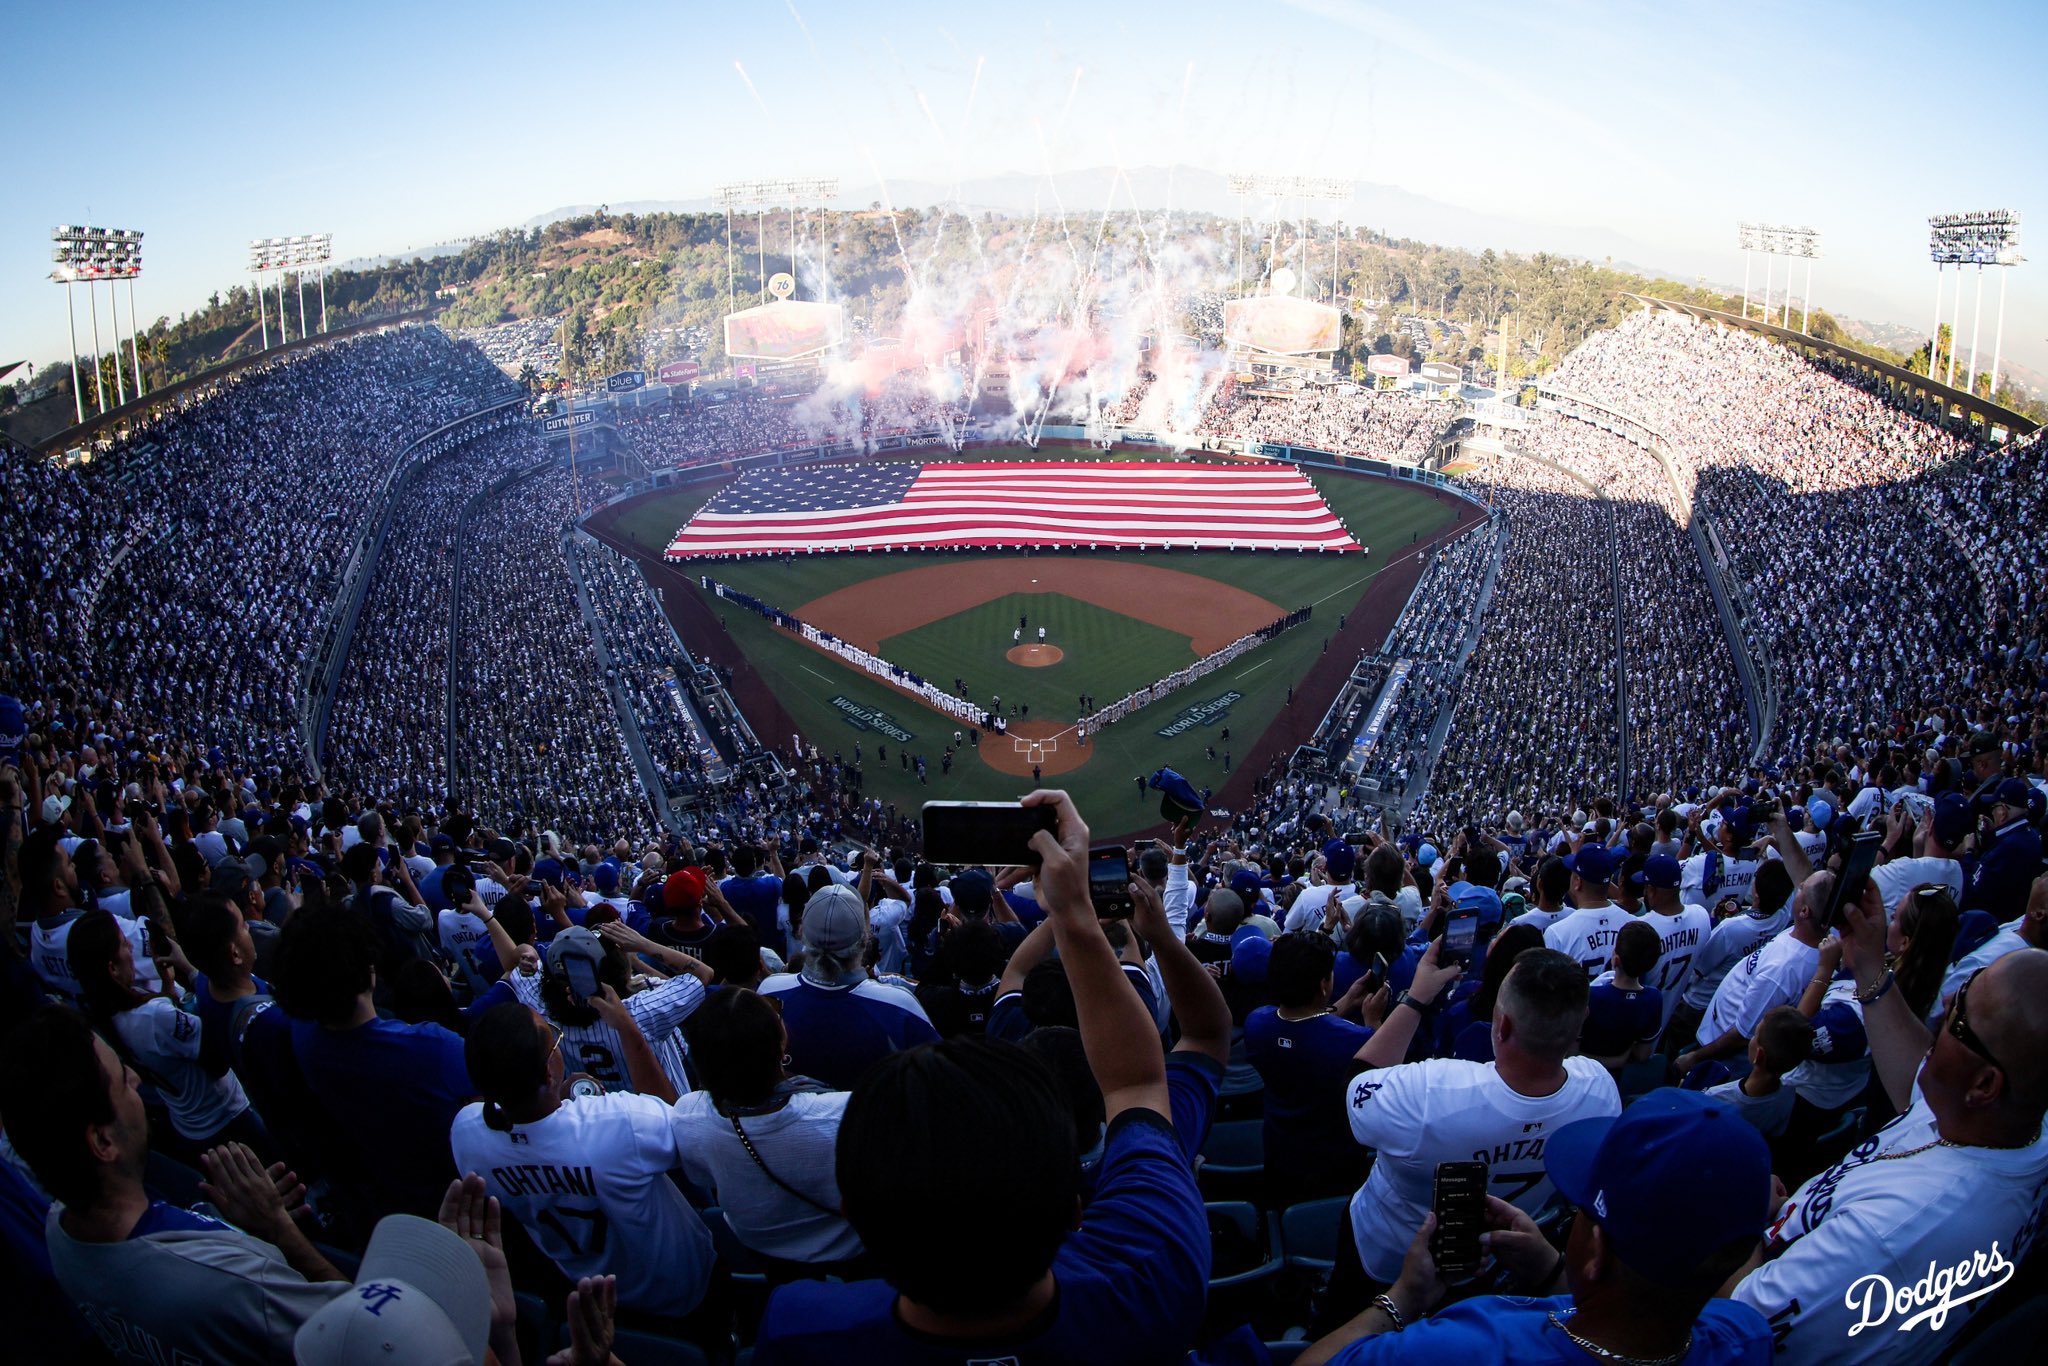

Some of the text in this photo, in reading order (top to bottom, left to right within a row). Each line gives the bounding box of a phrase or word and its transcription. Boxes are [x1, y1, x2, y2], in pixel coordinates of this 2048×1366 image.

[776, 280, 789, 290] 76
[610, 376, 632, 387] blue
[546, 412, 591, 430] CUTWATER
[911, 437, 943, 446] MORTON
[832, 696, 873, 721] WORLD
[868, 718, 912, 742] SERIES
[1159, 712, 1206, 737] WORLD
[1201, 691, 1241, 715] SERIES
[1719, 872, 1755, 889] REEMAN
[1205, 931, 1232, 943] ERIES
[1587, 930, 1619, 950] BETT
[1657, 953, 1693, 991] 17
[580, 1044, 621, 1081] 2
[1472, 1138, 1545, 1165] OHTA
[491, 1164, 597, 1197] OHTANI
[1489, 1171, 1548, 1203] 7
[536, 1204, 609, 1255] 17
